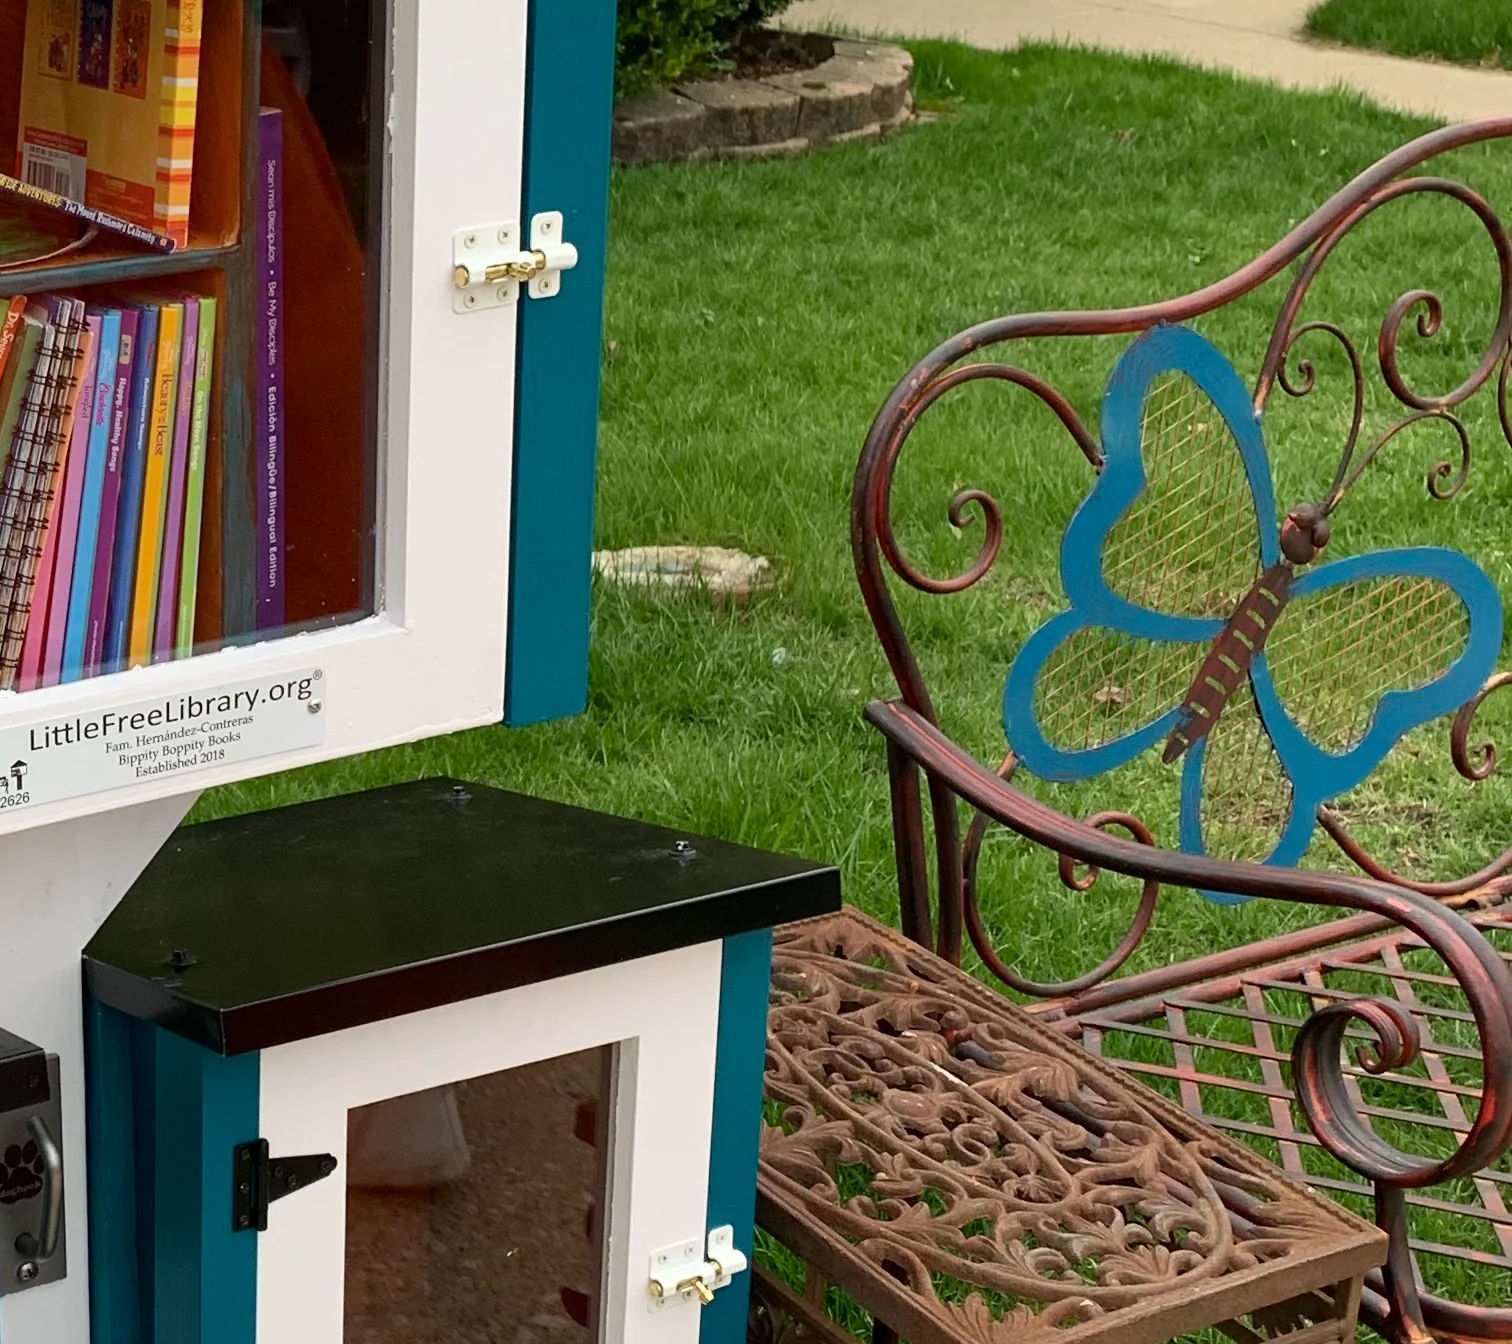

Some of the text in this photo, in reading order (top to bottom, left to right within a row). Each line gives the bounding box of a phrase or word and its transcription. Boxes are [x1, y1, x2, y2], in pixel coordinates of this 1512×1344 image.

[267, 159, 276, 189] Sean
[268, 281, 277, 297] Be
[3, 311, 19, 329] Dr.
[266, 299, 276, 317] My
[267, 318, 277, 366] Disciples
[157, 372, 172, 414] Beauty
[196, 390, 204, 403] On
[268, 386, 277, 432] Edición
[109, 377, 127, 472] Happy, Healthy Songs
[155, 424, 168, 456] Beast
[193, 419, 202, 443] Move
[190, 443, 200, 471] Songs
[268, 546, 277, 589] Edition
[29, 674, 313, 753] LittleFreeLibrary.org
[105, 714, 255, 755] Fam. Hernández-Contreras
[118, 731, 242, 768] Bippity Boppity Books
[136, 748, 226, 778] Established 2018
